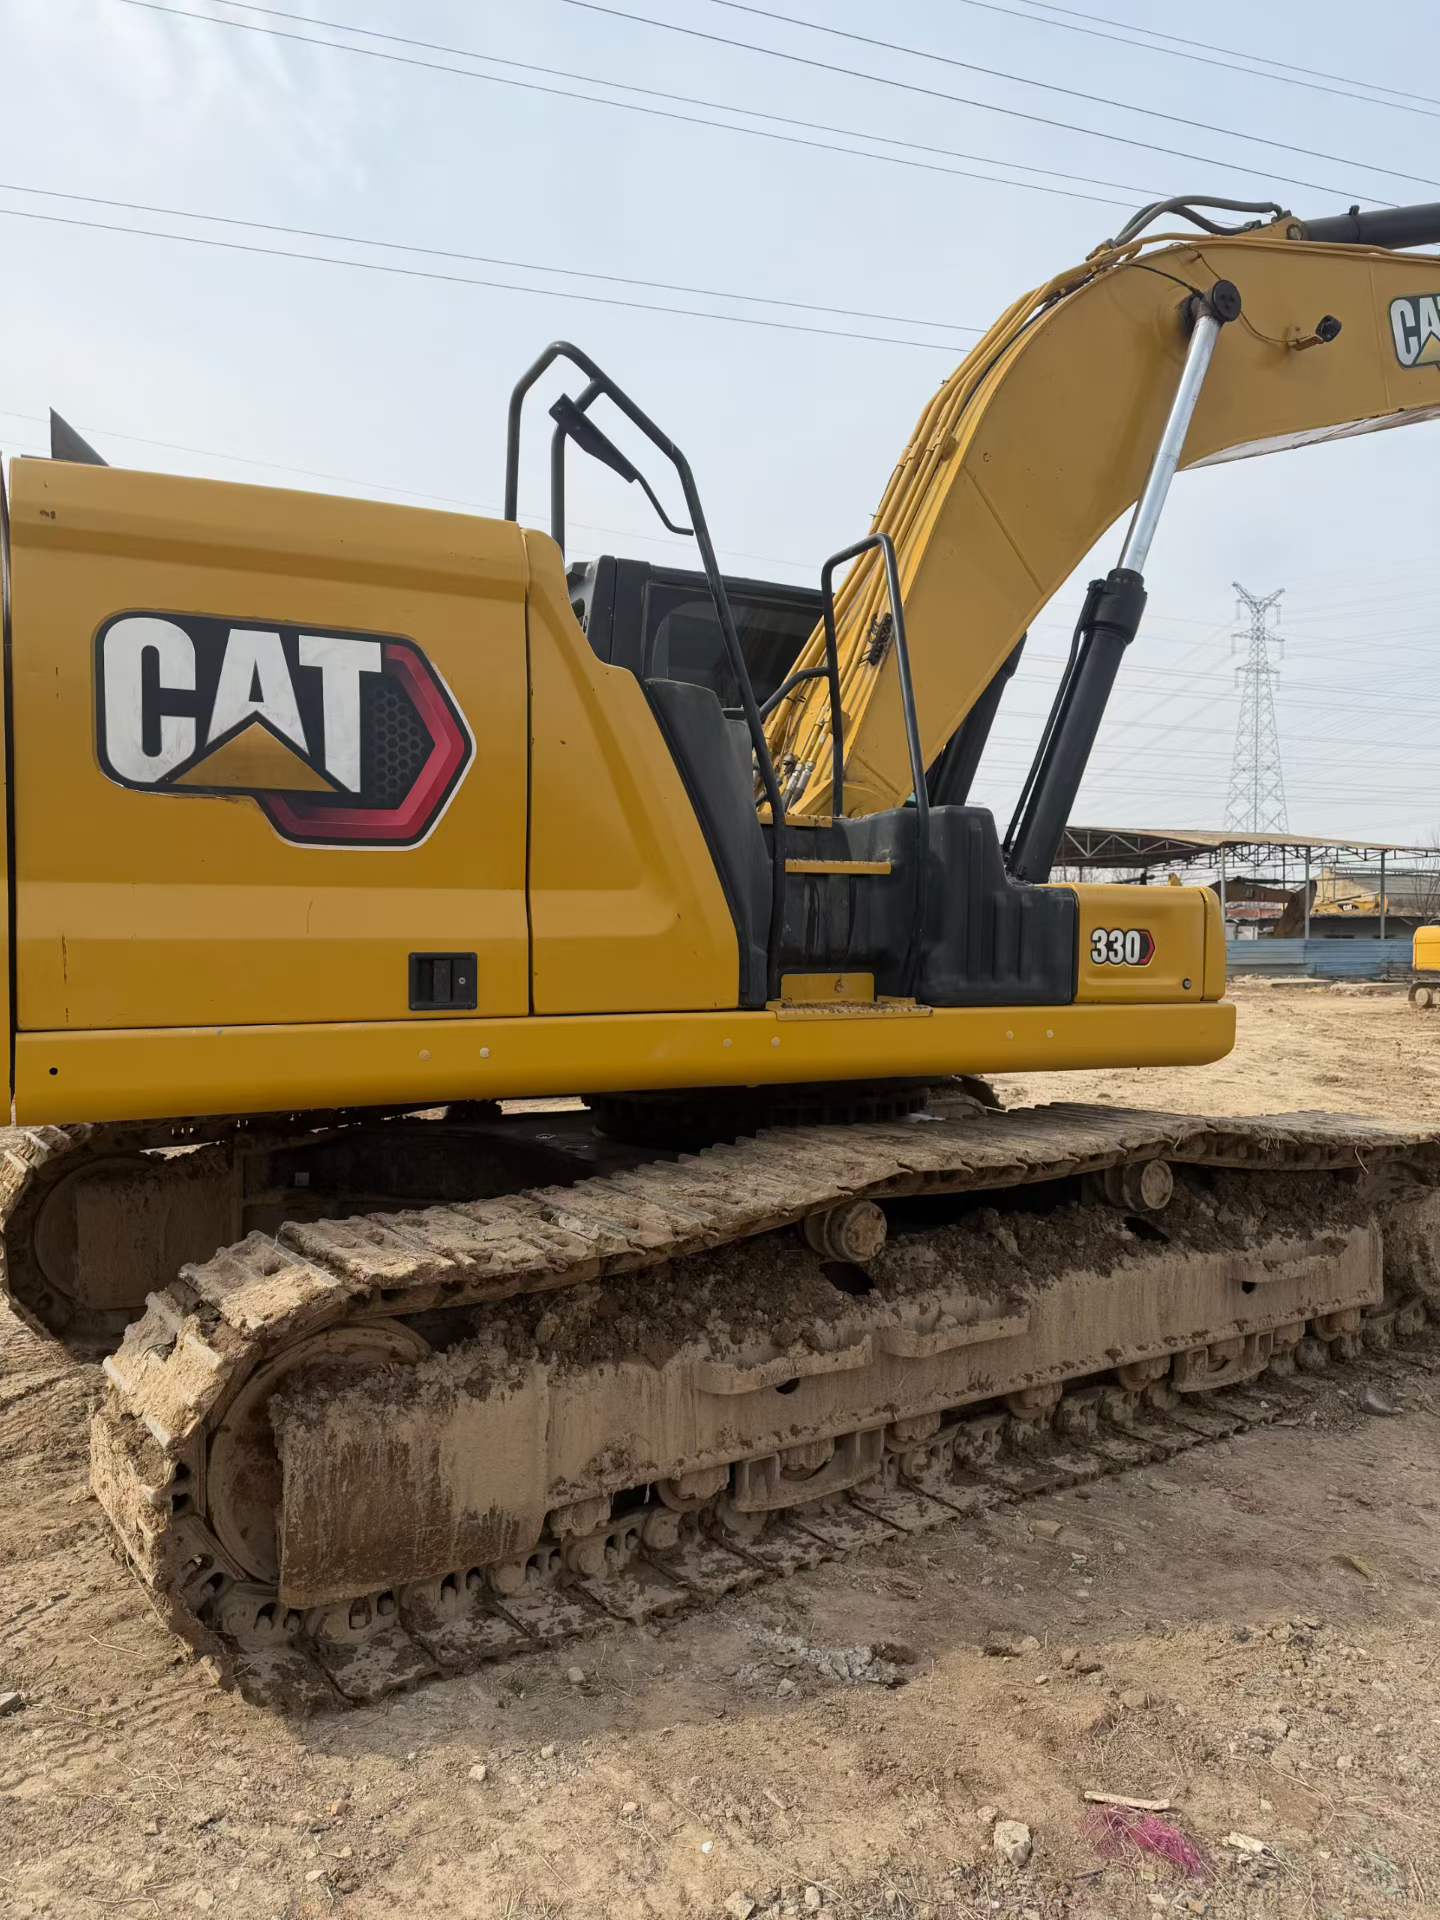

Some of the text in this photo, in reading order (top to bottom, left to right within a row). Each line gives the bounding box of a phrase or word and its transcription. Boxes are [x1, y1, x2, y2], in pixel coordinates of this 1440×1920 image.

[1390, 296, 1440, 366] CA
[103, 617, 382, 793] CAT
[1091, 928, 1141, 964] 330
